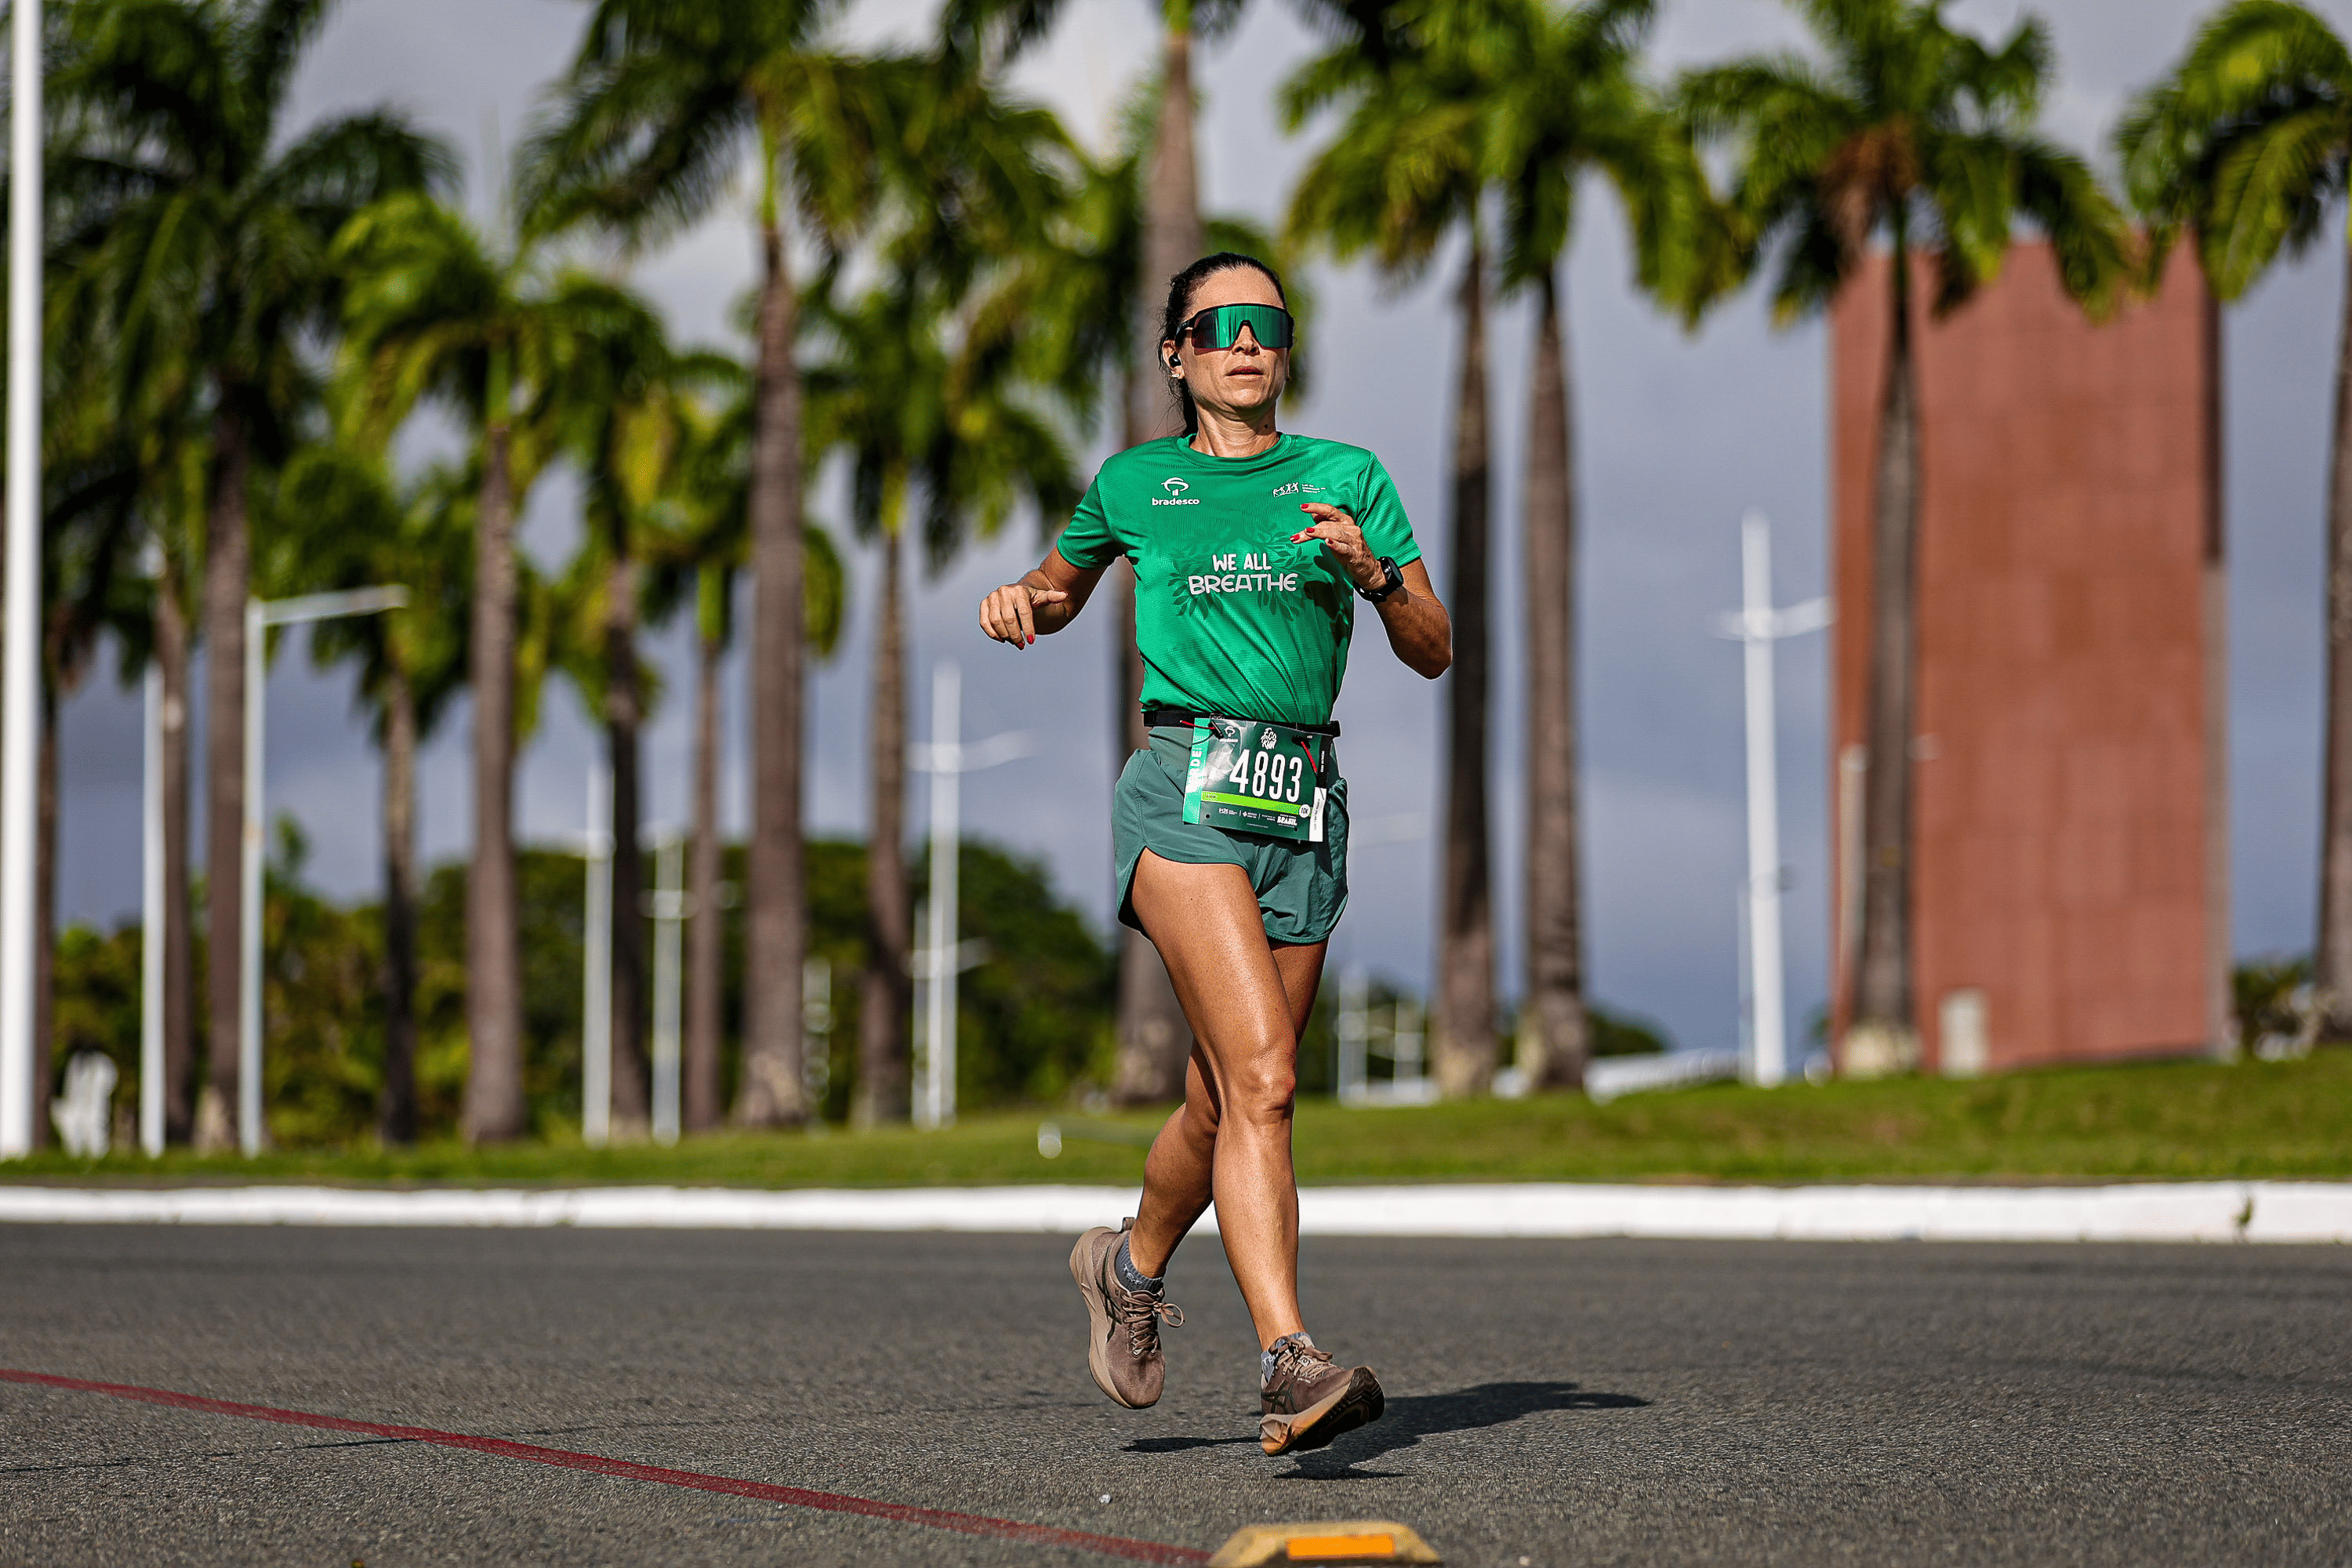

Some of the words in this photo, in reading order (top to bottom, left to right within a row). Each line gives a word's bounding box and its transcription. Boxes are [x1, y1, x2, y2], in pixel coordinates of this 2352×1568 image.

[1152, 496, 1200, 506] bradesco
[1212, 554, 1237, 572] WE
[1243, 552, 1272, 571] ALL
[1188, 573, 1299, 596] BREATHE
[1229, 749, 1303, 803] 4893
[1276, 816, 1298, 826] BRASIL
